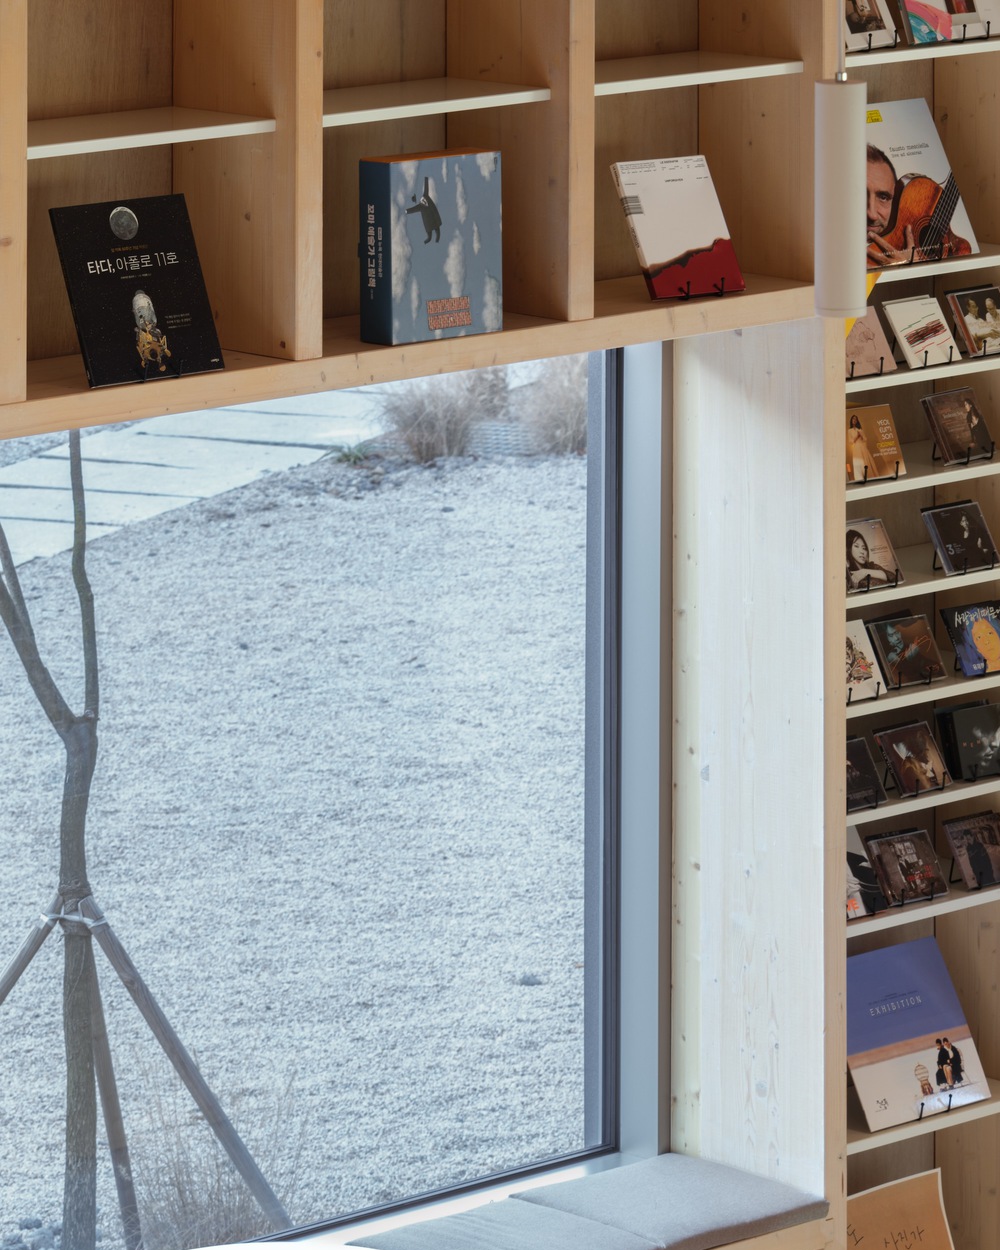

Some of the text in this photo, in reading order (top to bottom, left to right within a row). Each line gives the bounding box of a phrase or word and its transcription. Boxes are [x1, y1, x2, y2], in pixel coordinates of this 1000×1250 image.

[87, 252, 179, 274] 타다, 아폴로 11호
[870, 995, 922, 1017] EXHIBITION
